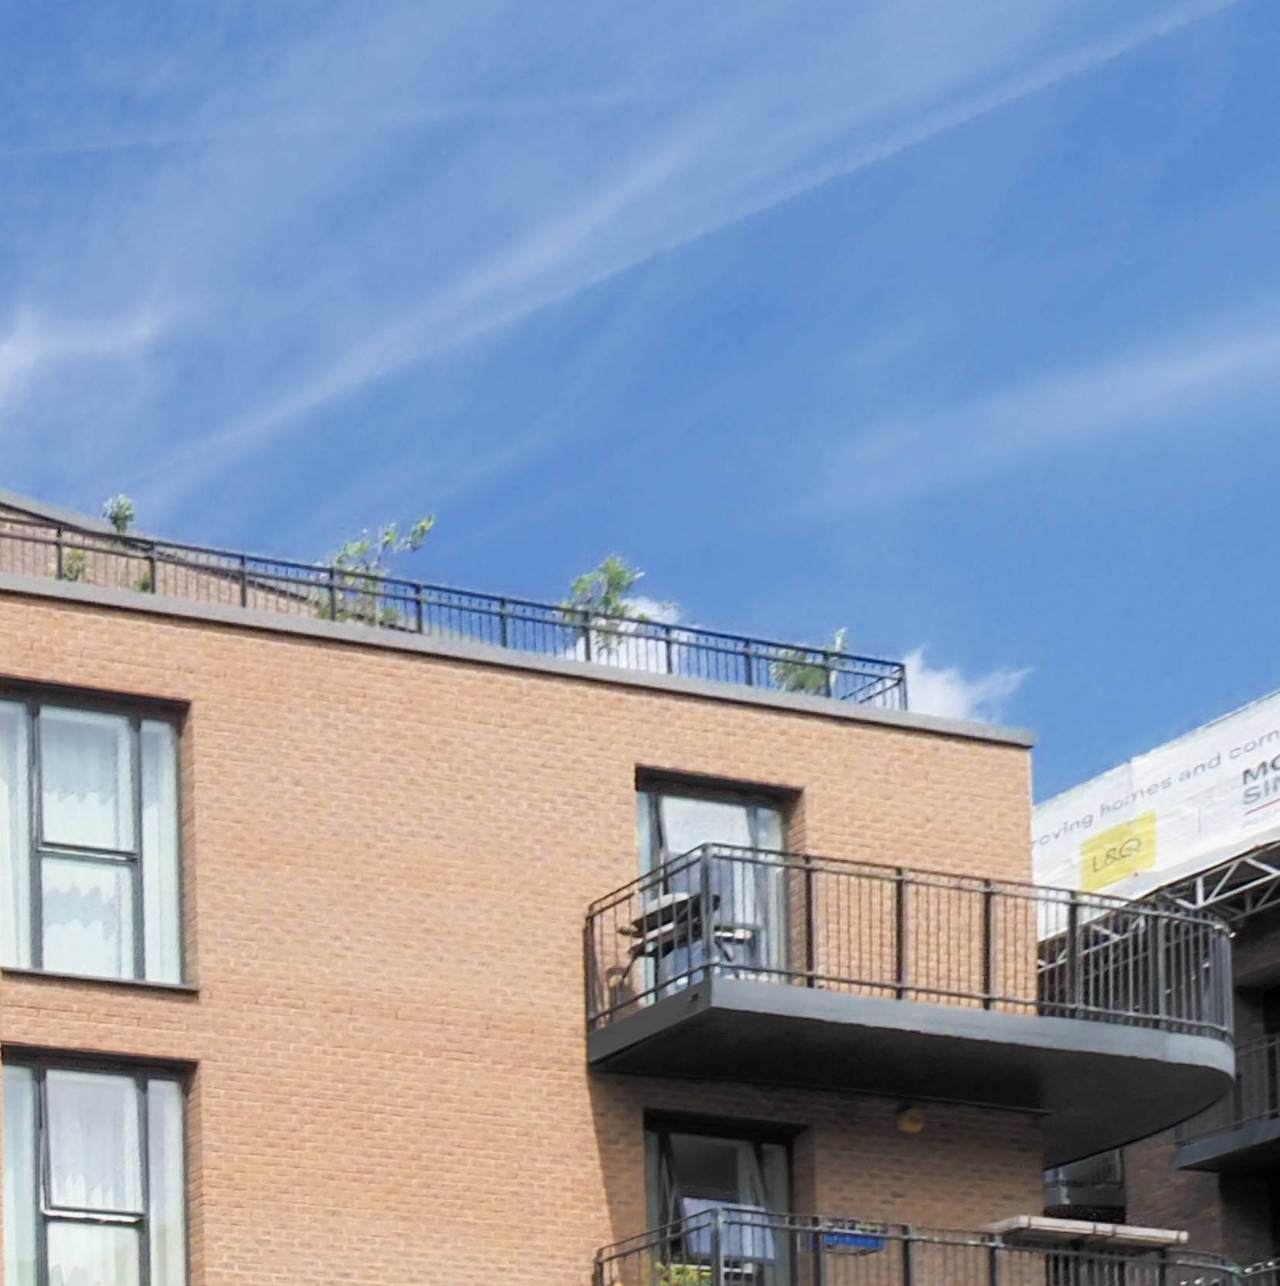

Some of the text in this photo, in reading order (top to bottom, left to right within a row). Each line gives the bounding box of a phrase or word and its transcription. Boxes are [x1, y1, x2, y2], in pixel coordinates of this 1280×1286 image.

[1100, 777, 1172, 817] homes
[1179, 753, 1221, 782] and
[1092, 838, 1141, 872] L&Q
